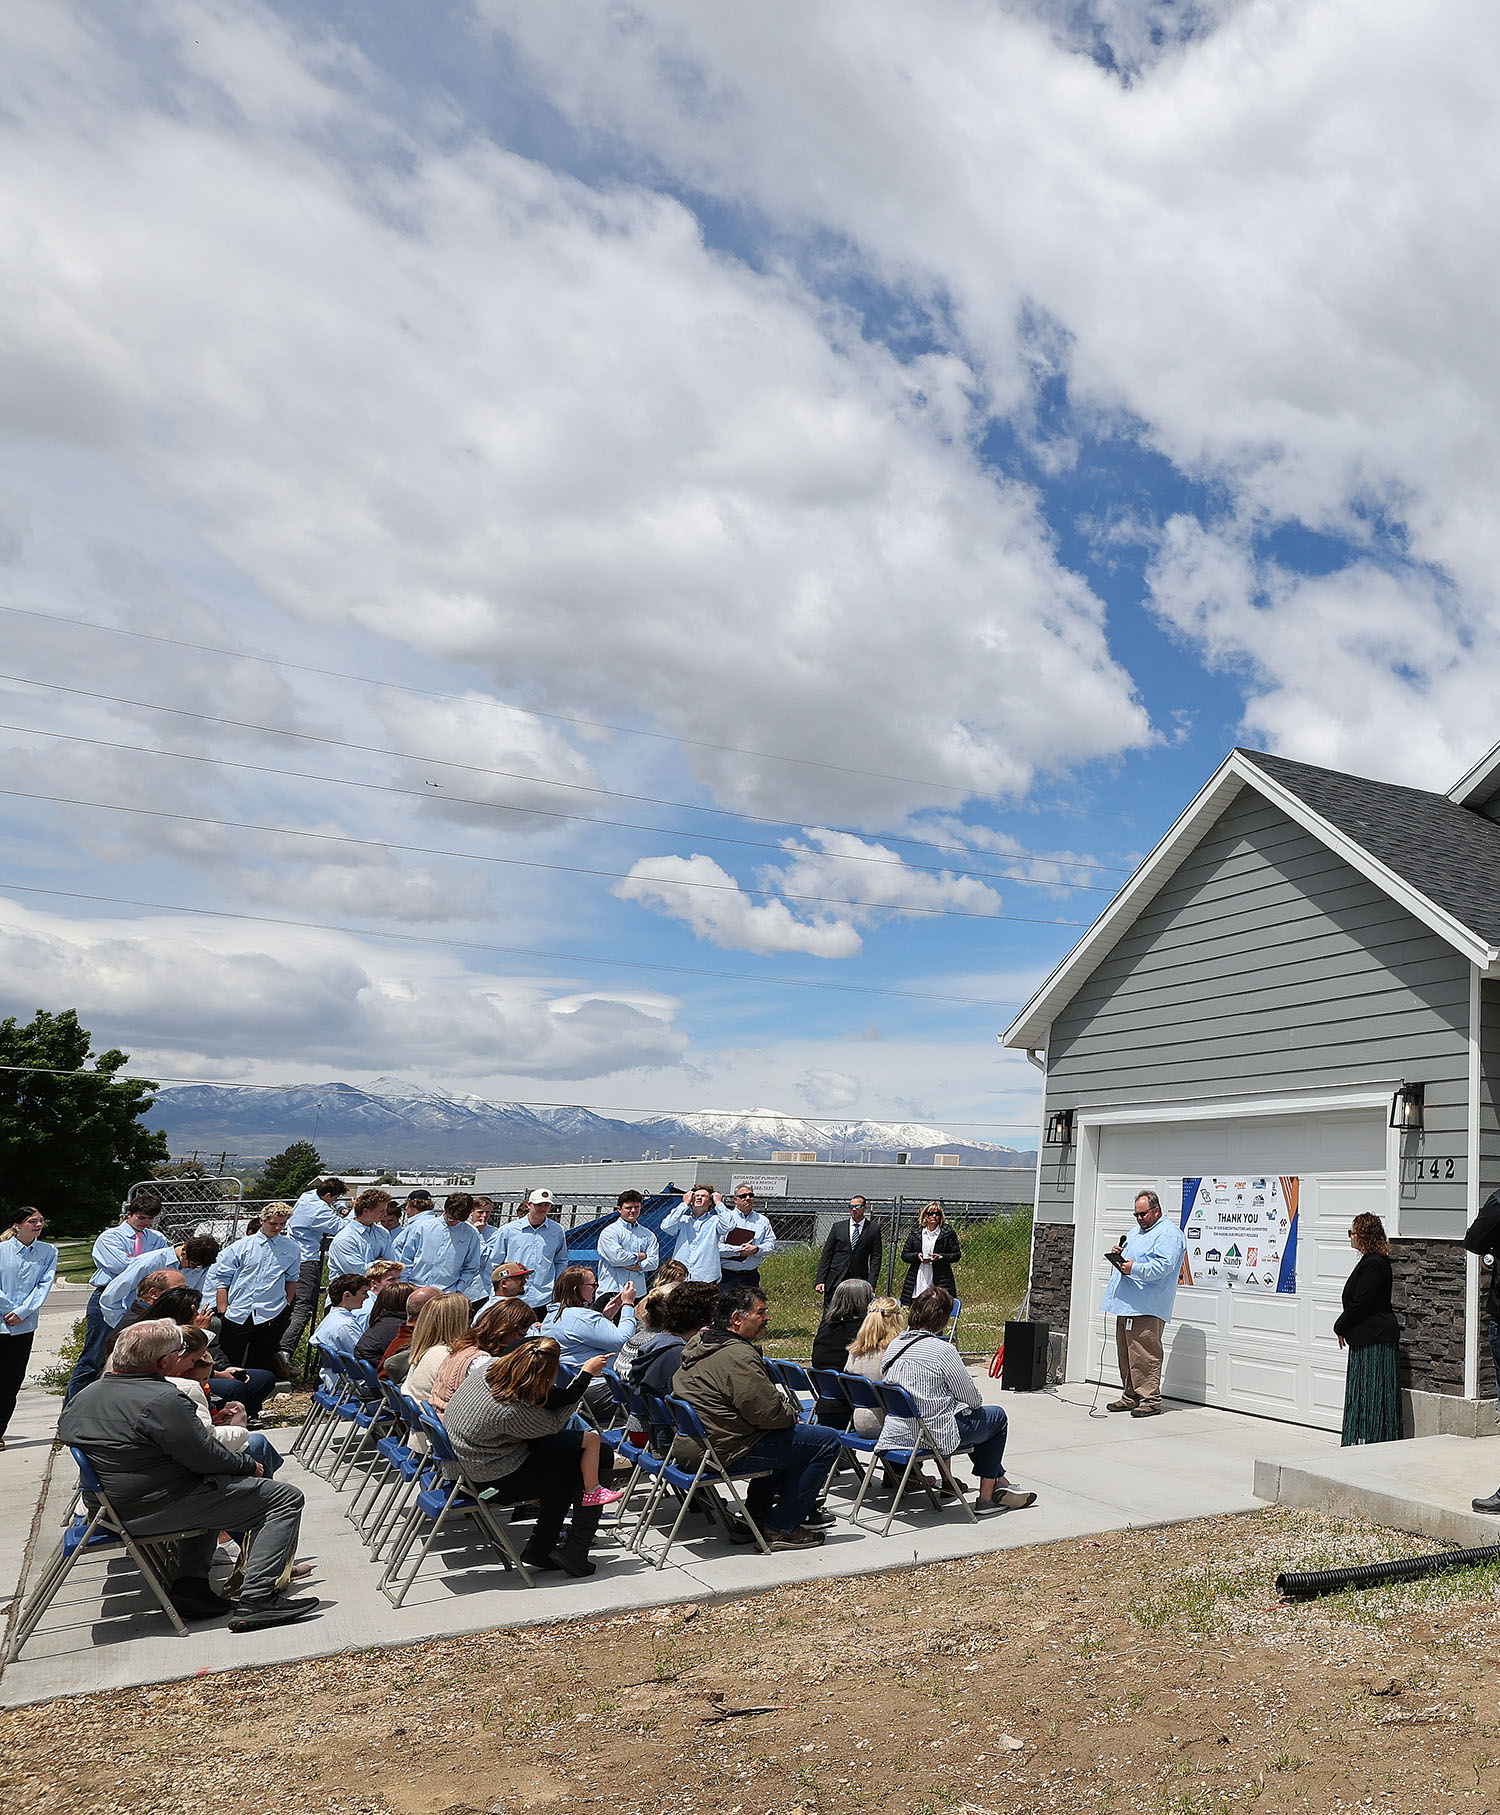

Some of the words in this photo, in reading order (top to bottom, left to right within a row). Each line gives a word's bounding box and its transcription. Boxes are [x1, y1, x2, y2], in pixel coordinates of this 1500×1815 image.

[1417, 1158, 1455, 1179] 142
[1218, 1213, 1241, 1223] THANK
[1244, 1214, 1258, 1223] YOU
[1223, 1256, 1242, 1268] Sandy
